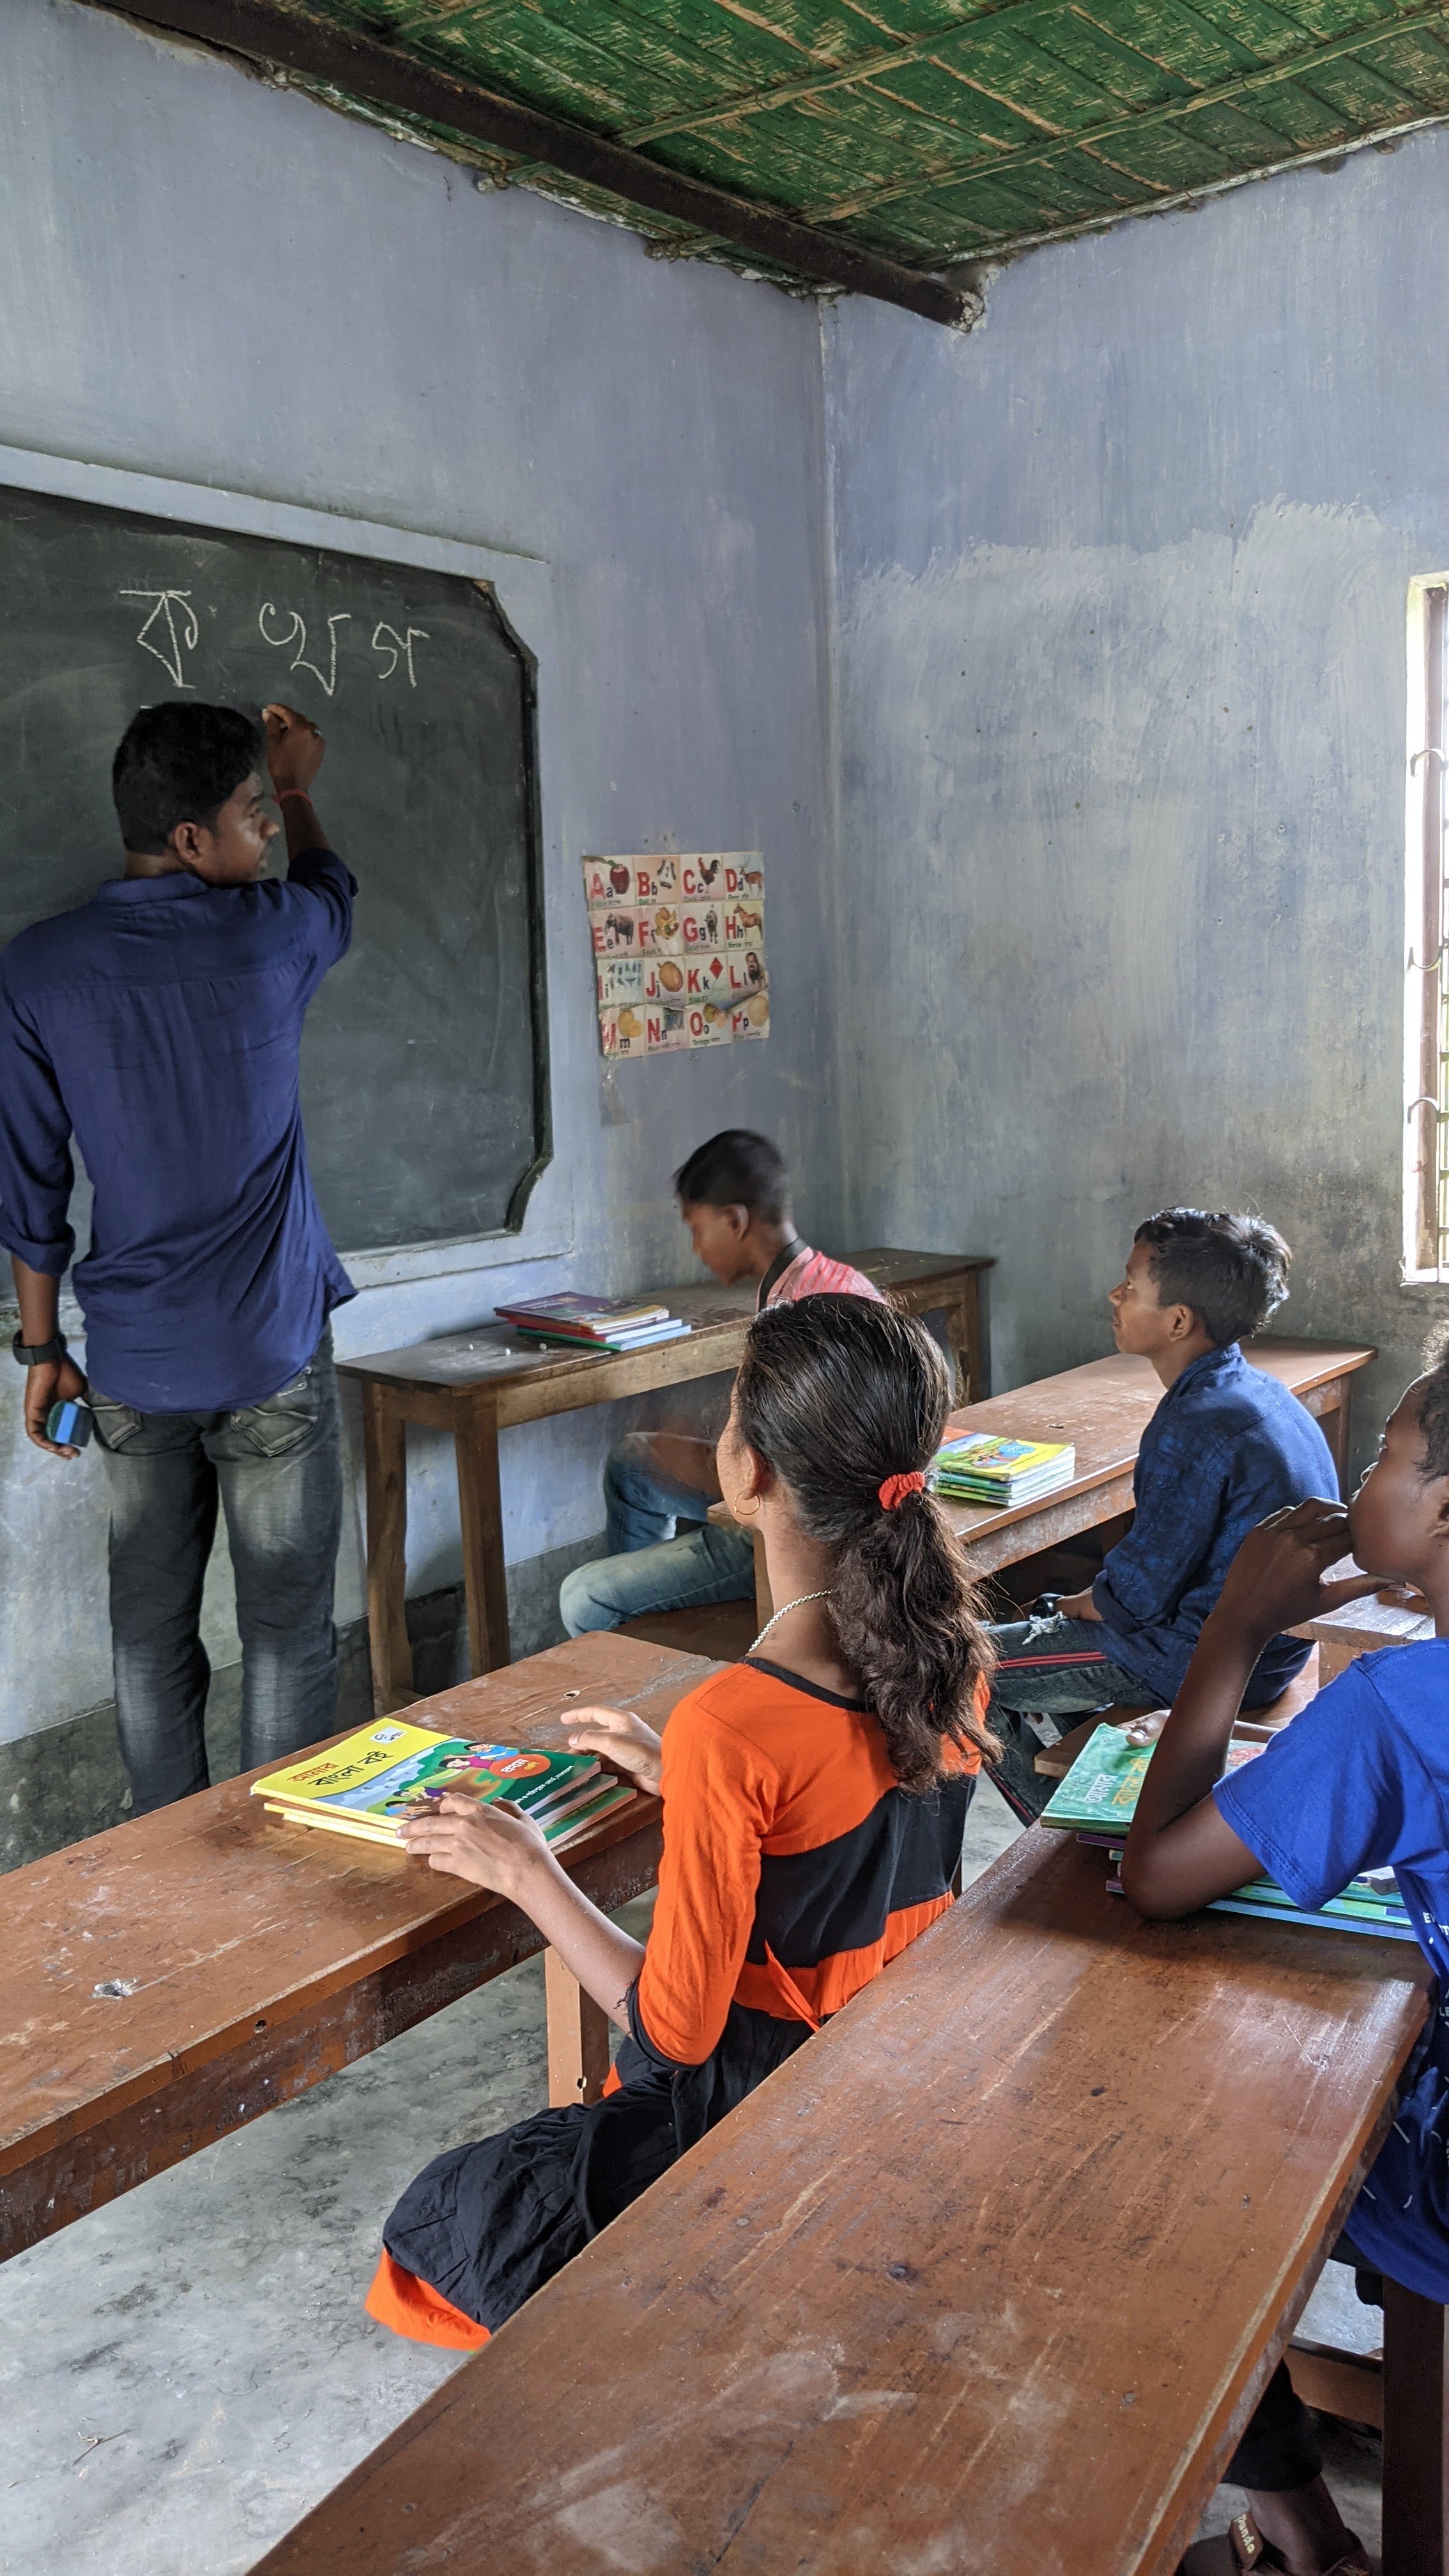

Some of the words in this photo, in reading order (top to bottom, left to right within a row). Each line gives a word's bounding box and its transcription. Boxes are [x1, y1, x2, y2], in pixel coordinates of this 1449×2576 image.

[119, 590, 199, 689] ক
[590, 873, 605, 900] A
[606, 887, 613, 898] a
[637, 872, 650, 896] B
[652, 882, 657, 896] b
[684, 870, 696, 894] C
[697, 883, 703, 893] c
[724, 869, 737, 893] D
[738, 878, 743, 891] d
[593, 927, 606, 953] E
[607, 939, 613, 949] e
[639, 921, 649, 947] F
[683, 917, 698, 942] G
[699, 927, 706, 941] g
[725, 916, 737, 940] H
[737, 925, 743, 939] h
[645, 972, 656, 997] J
[687, 969, 702, 993] K
[703, 976, 710, 990] k
[730, 965, 741, 989] L
[647, 1018, 661, 1043] N
[690, 1012, 703, 1036] O
[704, 1024, 709, 1034] o
[743, 1017, 749, 1031] p
[620, 1038, 631, 1048] m
[287, 1762, 339, 1782] আমার
[307, 1765, 364, 1786] বাংলা
[356, 1751, 395, 1765] বই
[1083, 1773, 1118, 1804] আমার
[1233, 2513, 1255, 2554] Panda
